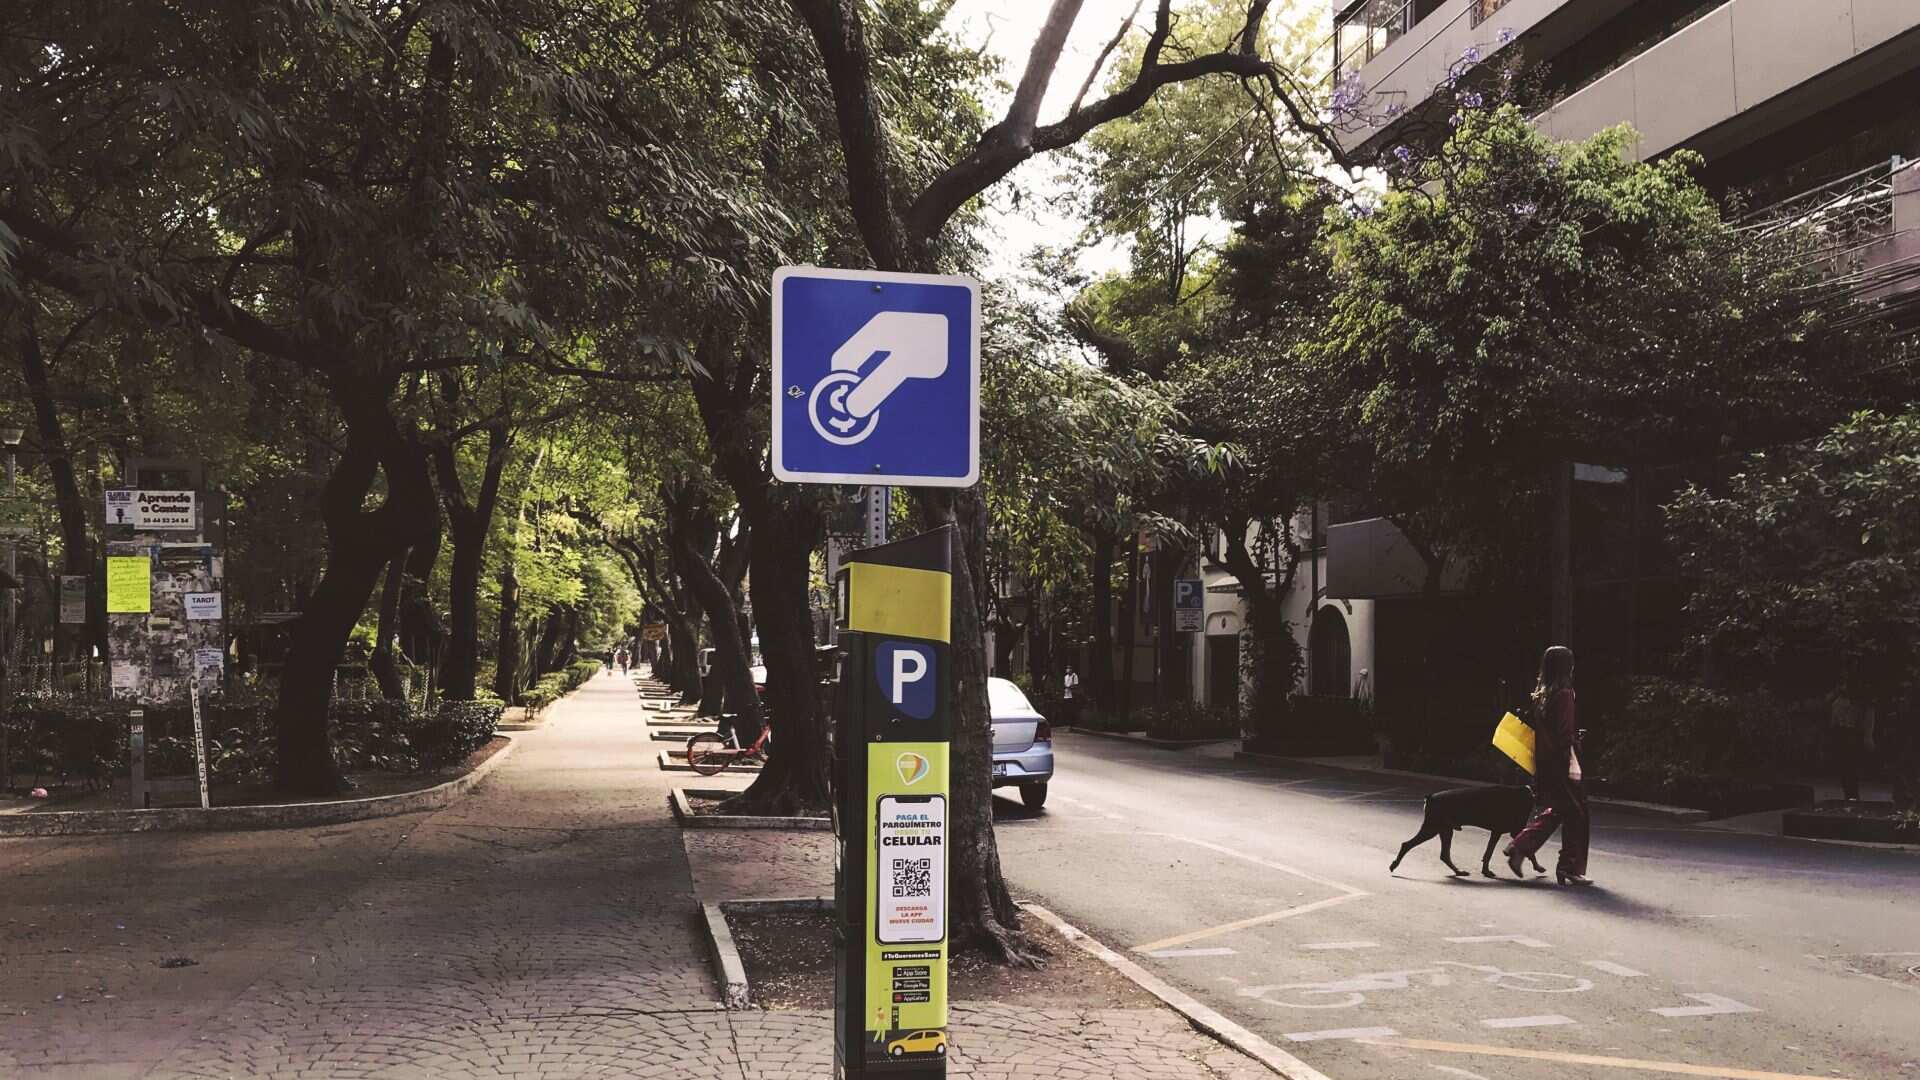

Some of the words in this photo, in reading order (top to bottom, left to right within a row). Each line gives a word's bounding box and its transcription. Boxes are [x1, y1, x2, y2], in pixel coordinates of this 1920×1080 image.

[138, 493, 191, 504] Aprende
[151, 504, 190, 513] Cantar
[1177, 582, 1192, 603] P
[893, 650, 927, 703] P
[883, 836, 942, 846] CELULAR
